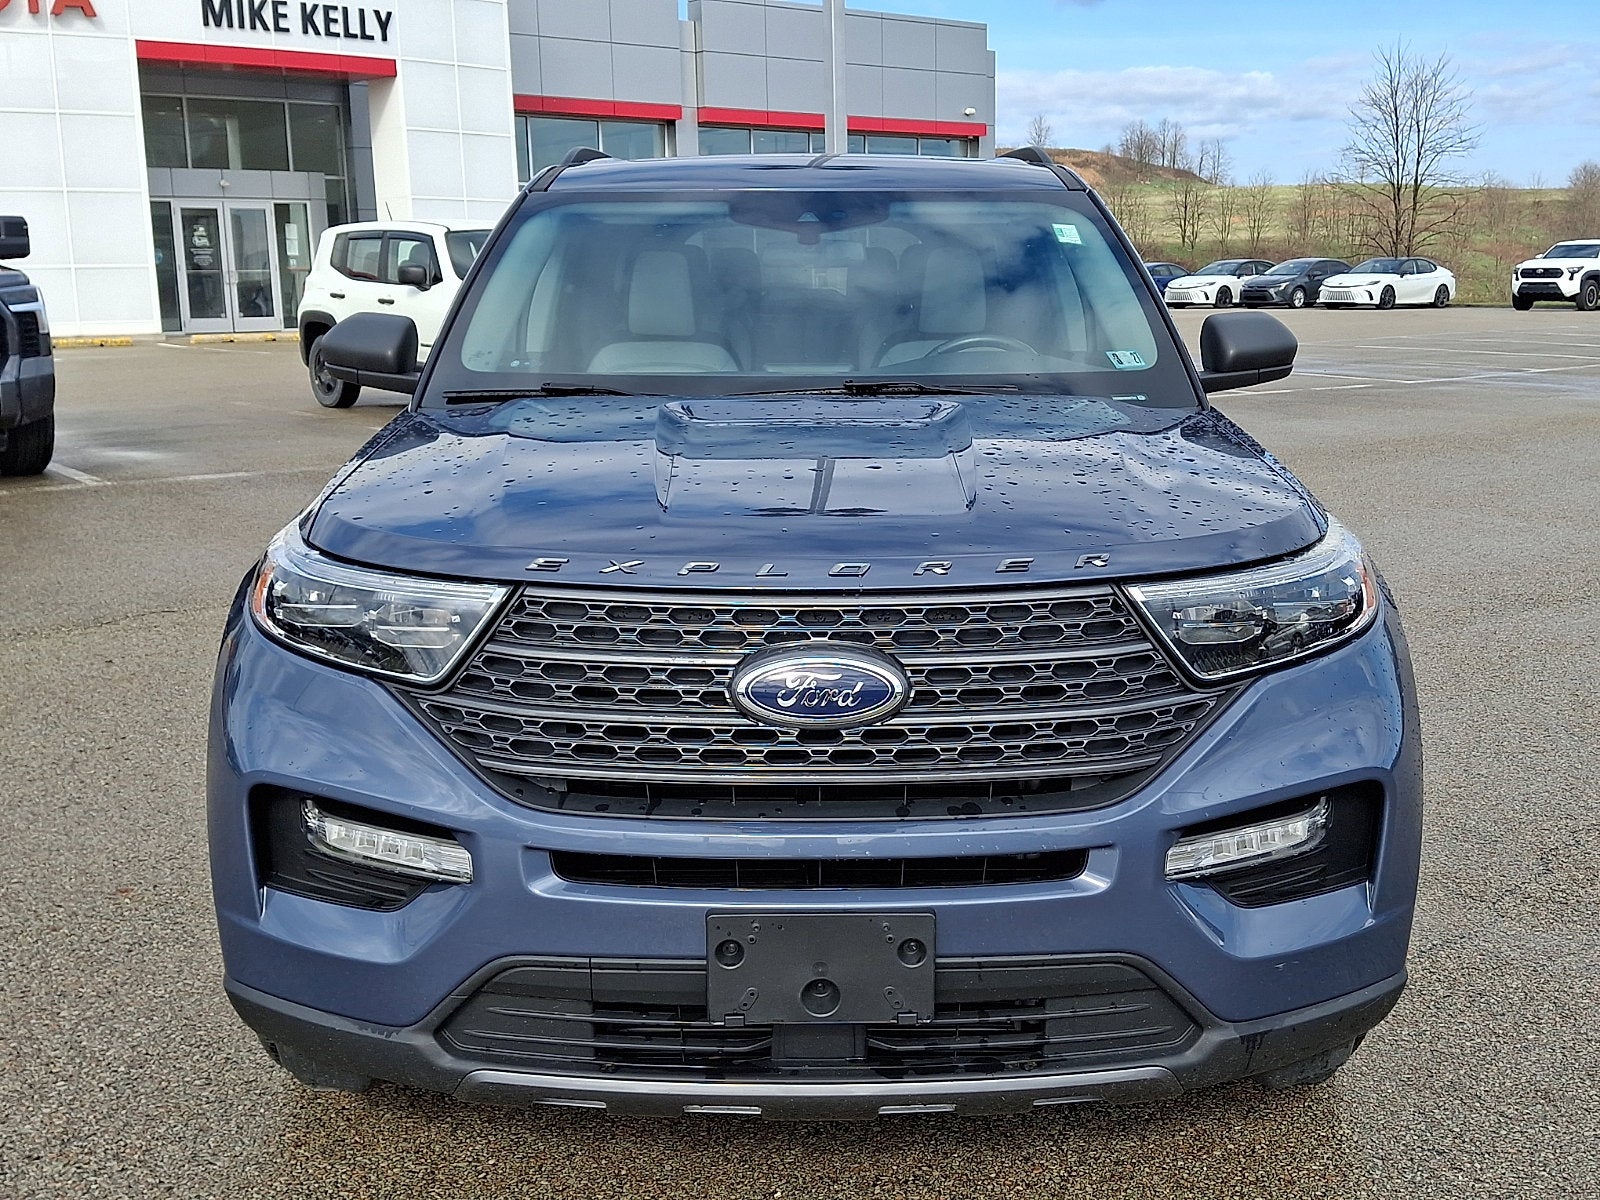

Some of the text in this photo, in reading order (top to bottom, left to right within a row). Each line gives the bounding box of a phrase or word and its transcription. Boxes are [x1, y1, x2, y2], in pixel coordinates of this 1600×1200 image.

[201, 0, 392, 42] MIKE KELLY
[525, 553, 1110, 577] EXPLORER
[776, 671, 864, 708] Ford
